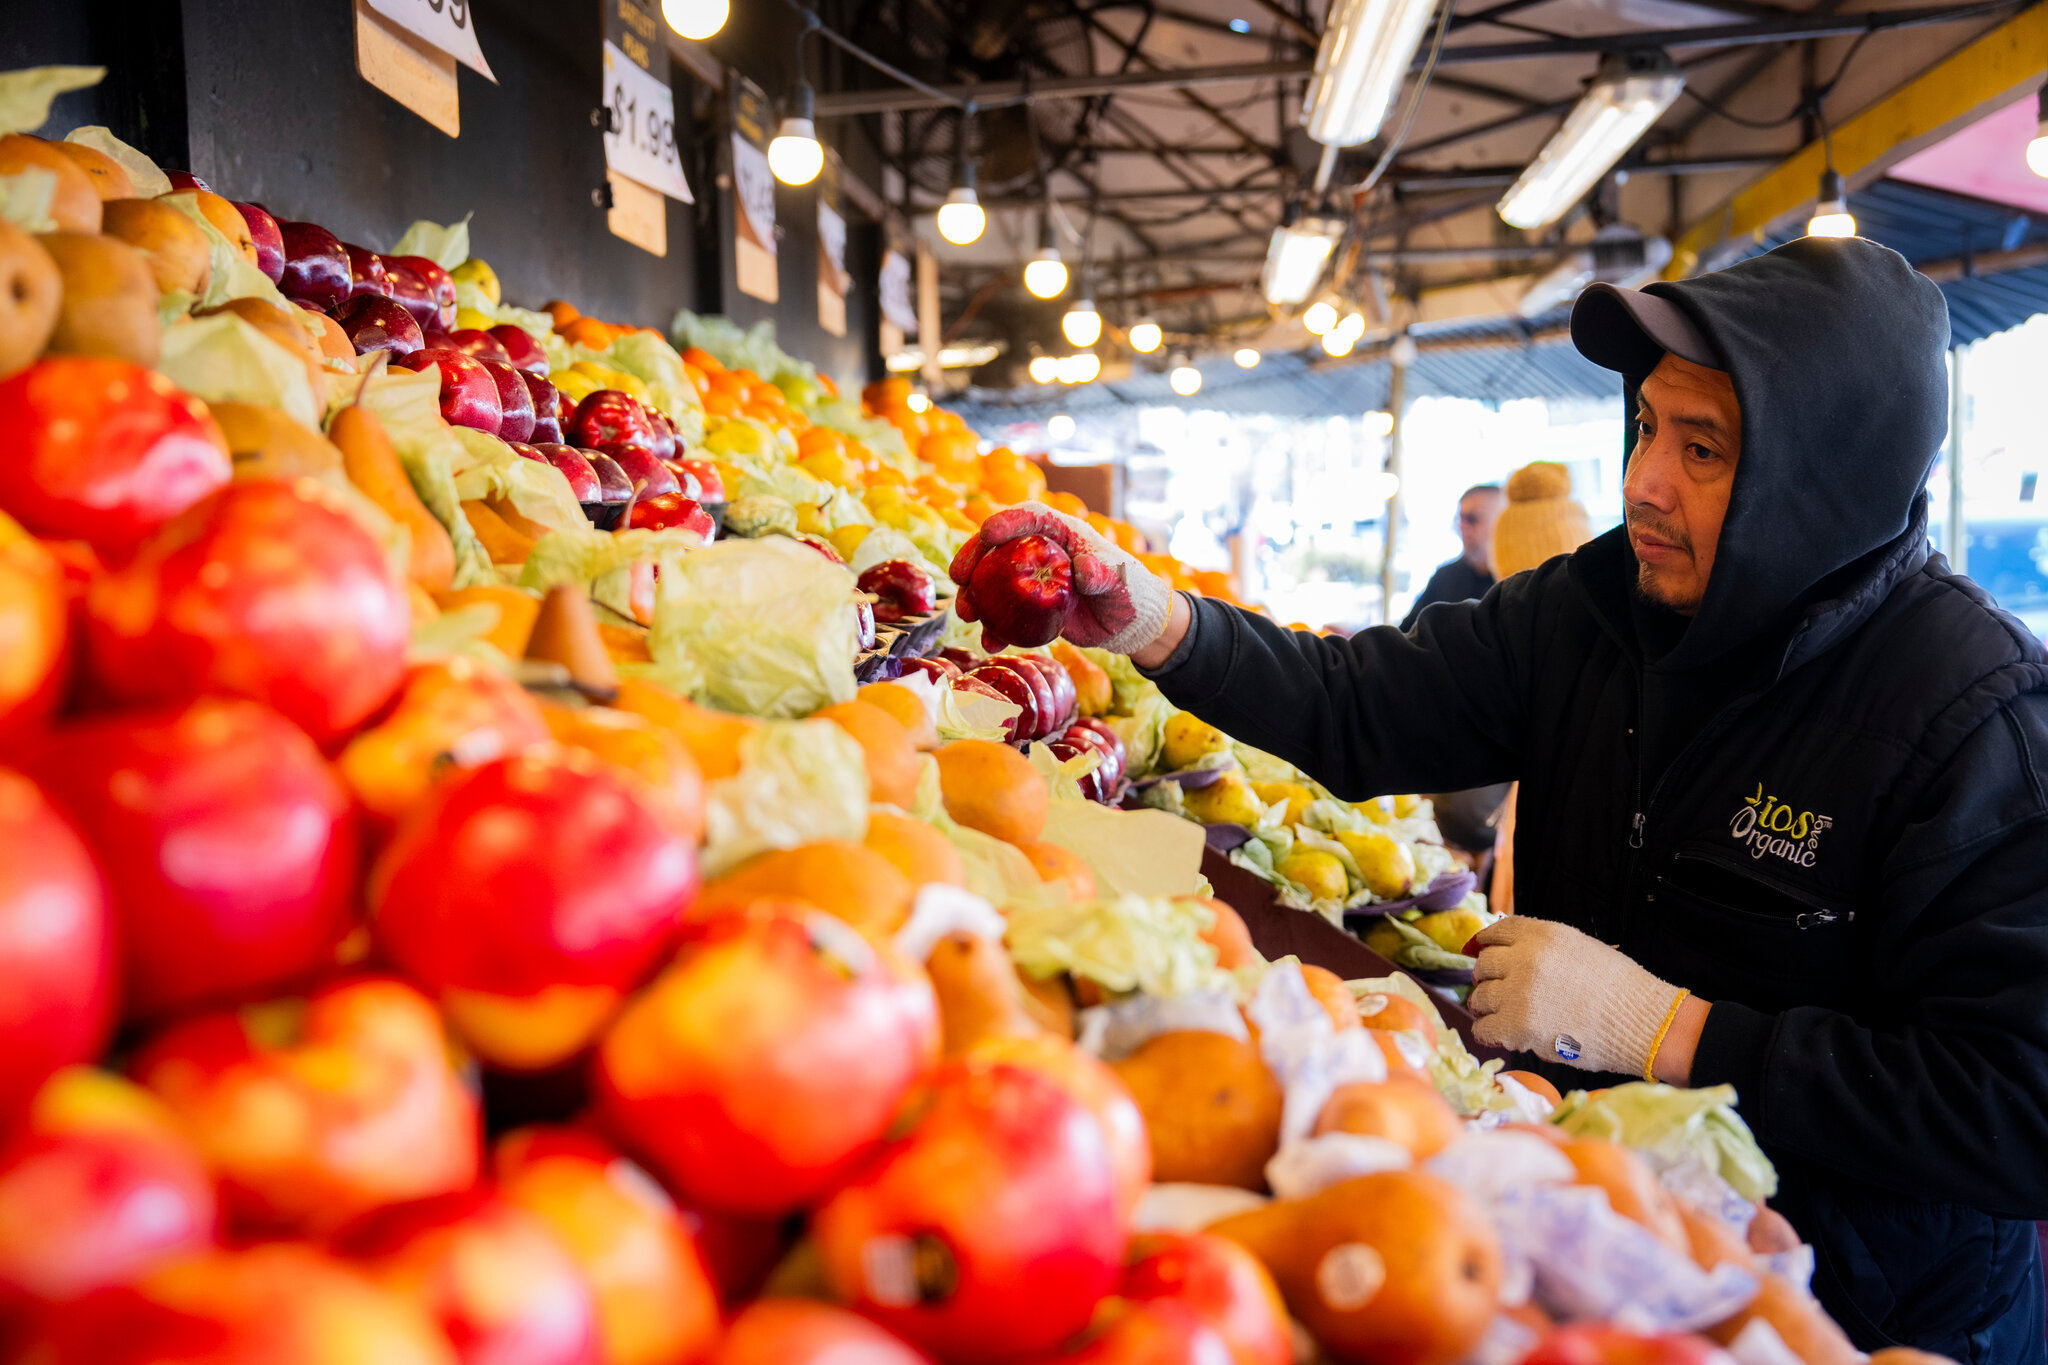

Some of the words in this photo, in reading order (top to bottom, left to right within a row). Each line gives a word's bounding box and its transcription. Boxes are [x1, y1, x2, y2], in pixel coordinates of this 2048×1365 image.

[611, 84, 676, 164] $1.99
[1729, 805, 1816, 867] Organic
[1807, 815, 1833, 850] love
